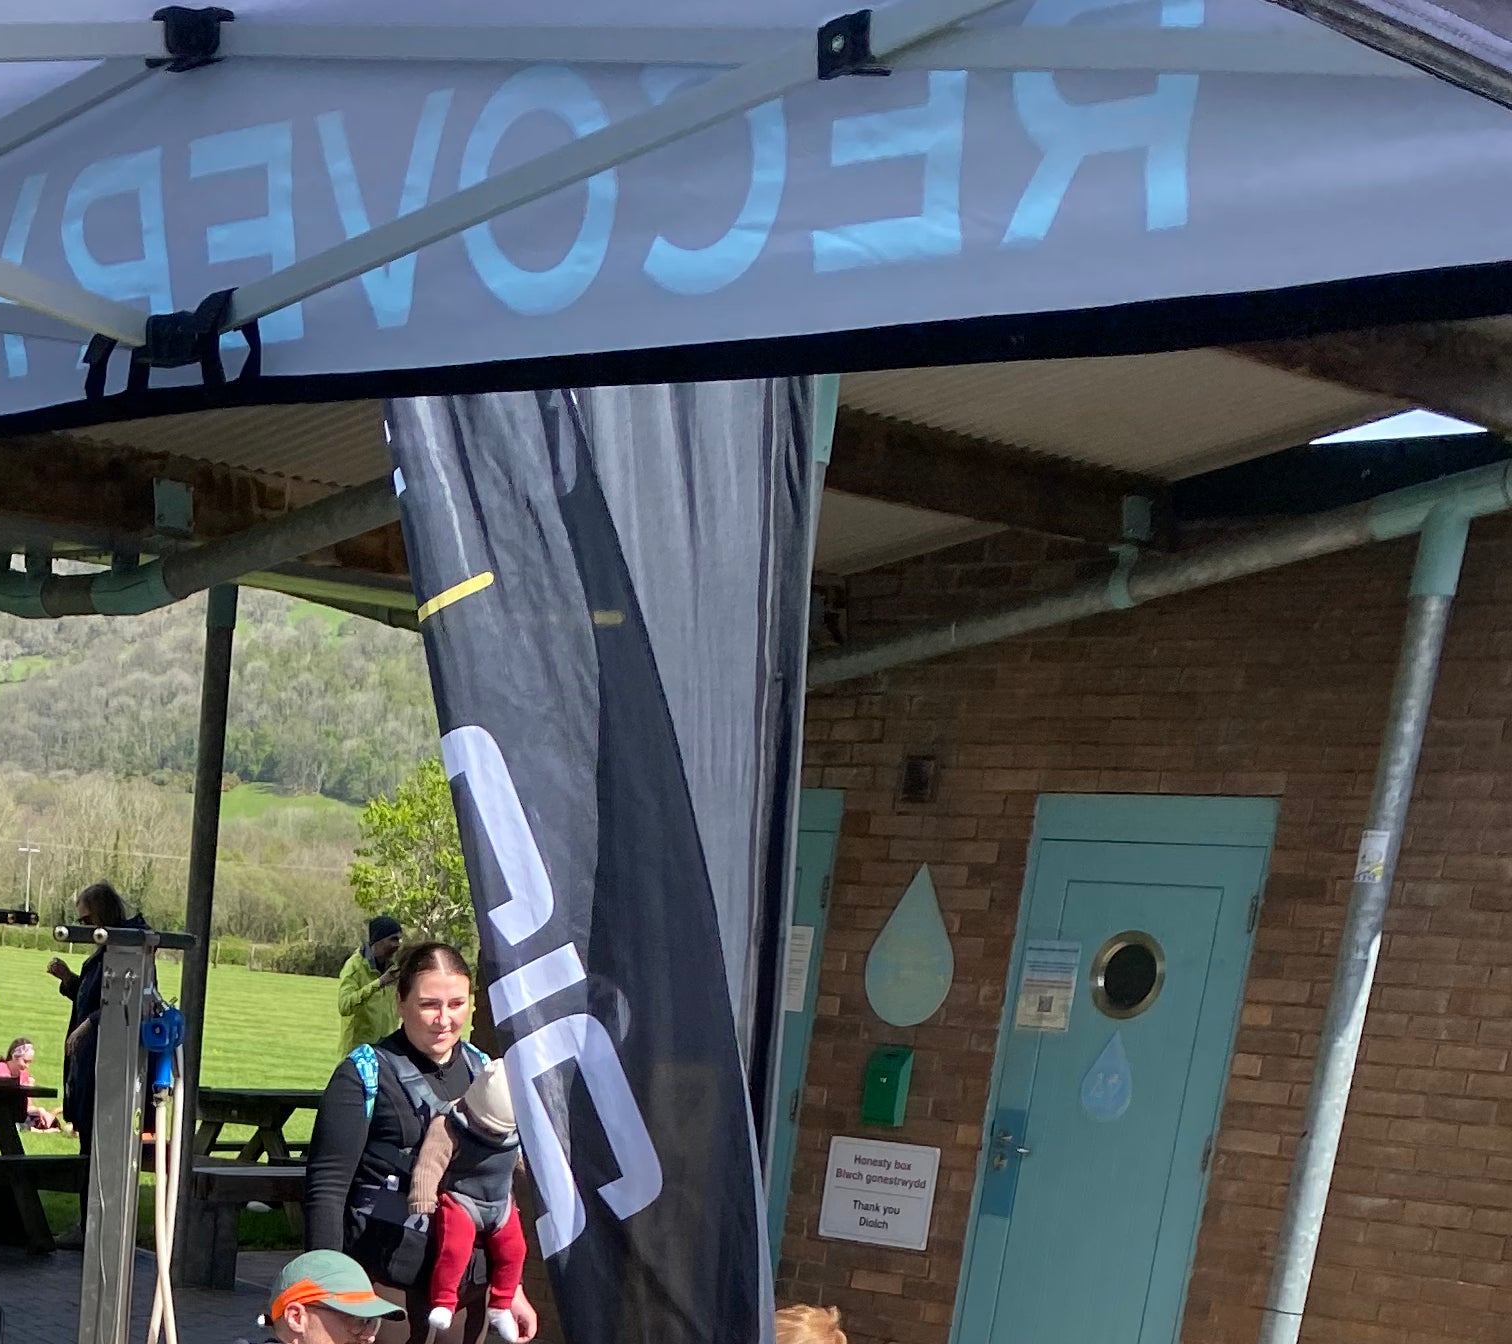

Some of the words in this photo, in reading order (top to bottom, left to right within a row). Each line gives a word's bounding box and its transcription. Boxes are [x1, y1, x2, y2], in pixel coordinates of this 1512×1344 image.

[854, 1154, 892, 1171] Honesty
[894, 1160, 913, 1171] box
[835, 1168, 864, 1180] Blwch
[865, 1174, 927, 1190] gonestrwydd
[853, 1199, 880, 1212] Thank
[882, 1205, 901, 1216] you
